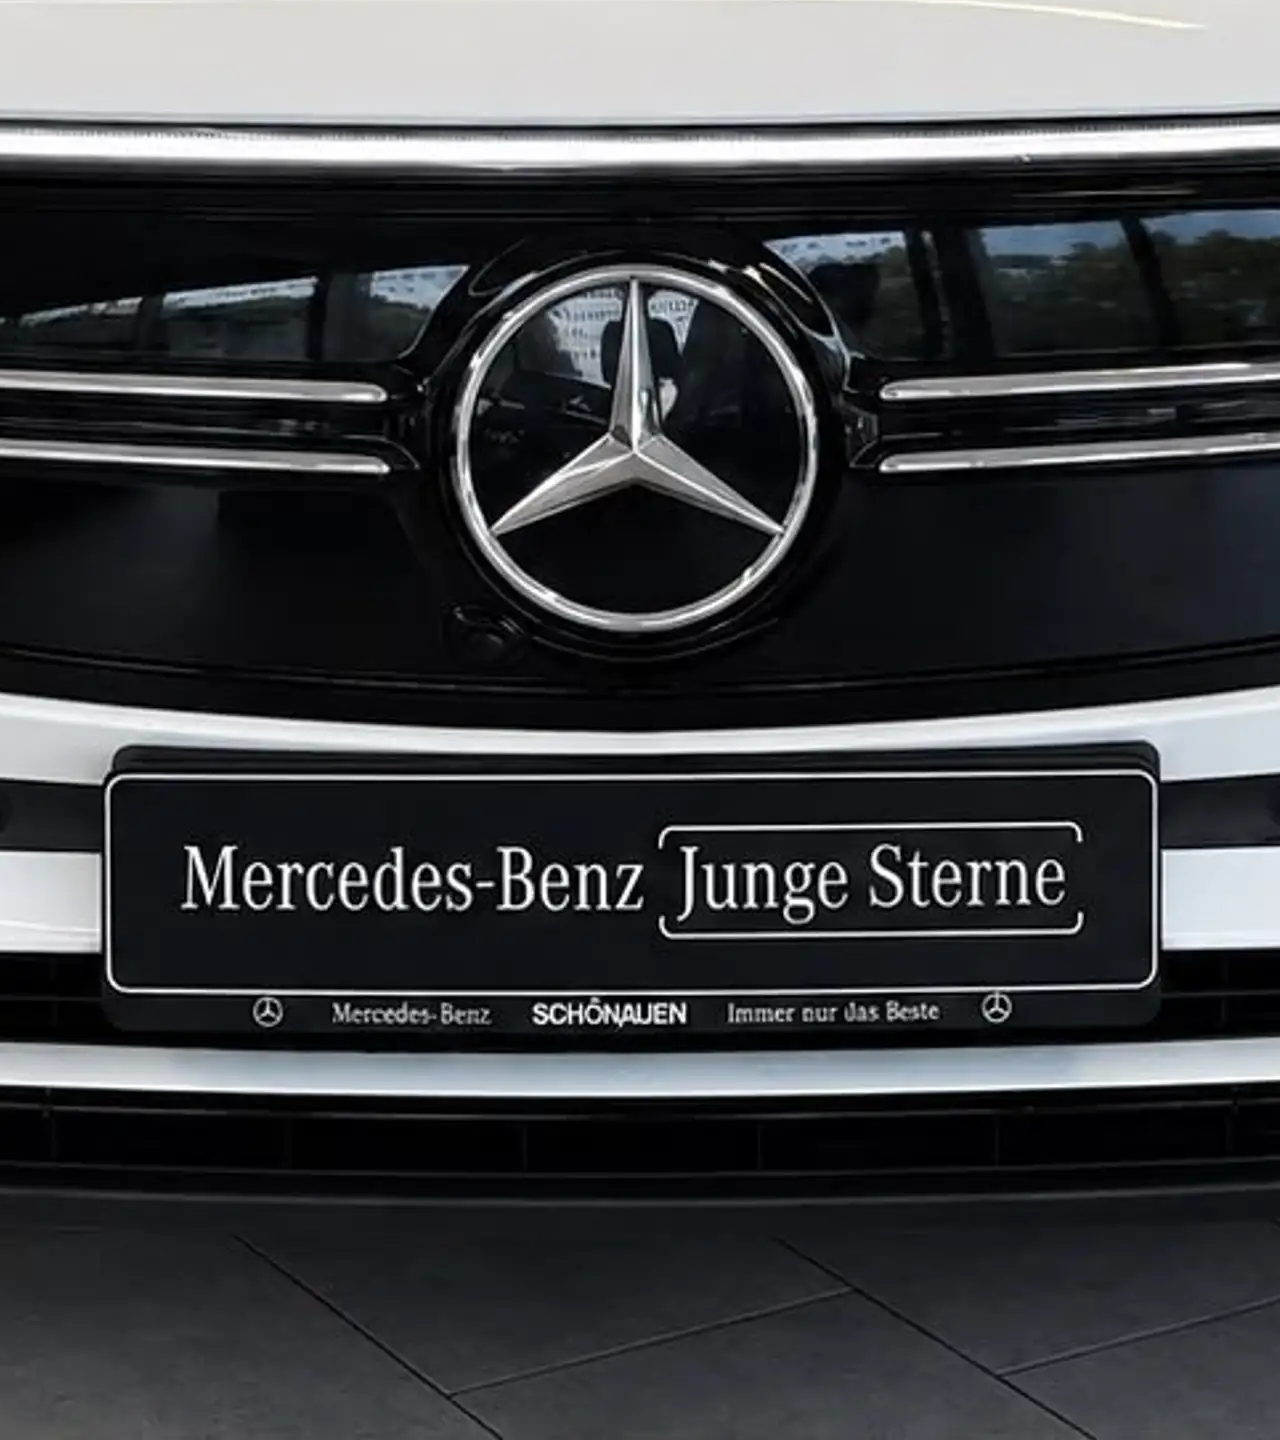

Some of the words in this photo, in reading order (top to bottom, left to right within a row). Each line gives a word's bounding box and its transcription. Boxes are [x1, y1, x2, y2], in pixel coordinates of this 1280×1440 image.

[181, 845, 644, 912] Mercedes-Benz
[676, 844, 848, 925] Junge
[869, 843, 1065, 909] Sterne
[331, 1001, 492, 1025] Mercedes-Benz
[532, 997, 687, 1027] SCHÖNAUEN
[726, 1002, 795, 1024] Immer
[801, 1004, 838, 1023] nur
[843, 1001, 880, 1022] das
[885, 1000, 941, 1021] Beste
